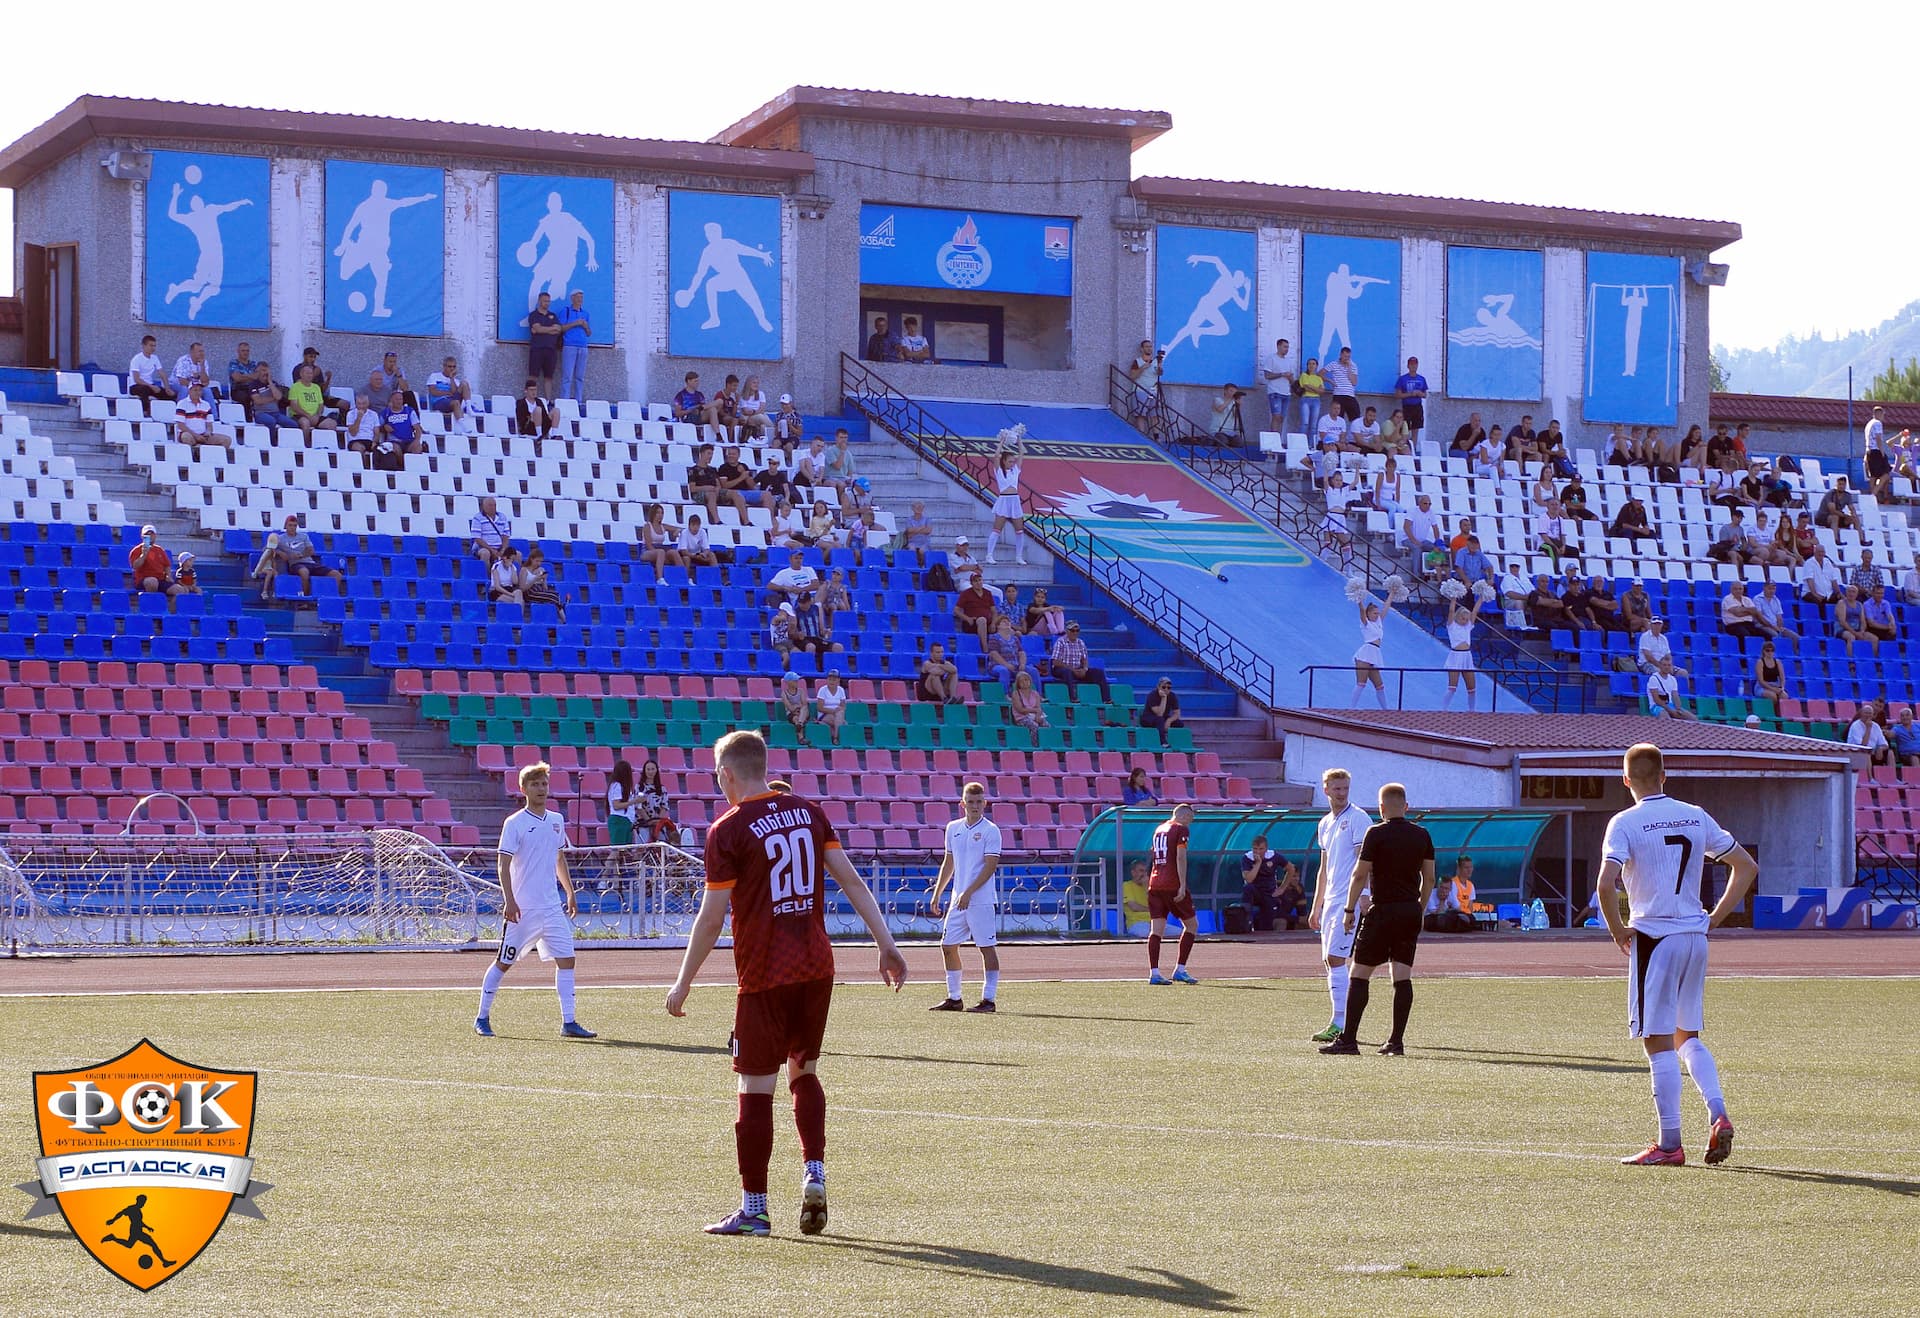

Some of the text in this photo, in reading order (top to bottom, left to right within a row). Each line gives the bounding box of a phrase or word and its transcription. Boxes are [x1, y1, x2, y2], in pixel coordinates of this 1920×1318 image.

[859, 235, 896, 248] УЗБАСС
[749, 808, 812, 839] БОБЕШКО
[764, 827, 816, 903] 20
[1664, 834, 1693, 895] 7
[1815, 905, 1824, 927] 2
[1861, 903, 1868, 926] 1
[1906, 911, 1915, 928] 3
[503, 944, 517, 960] 19
